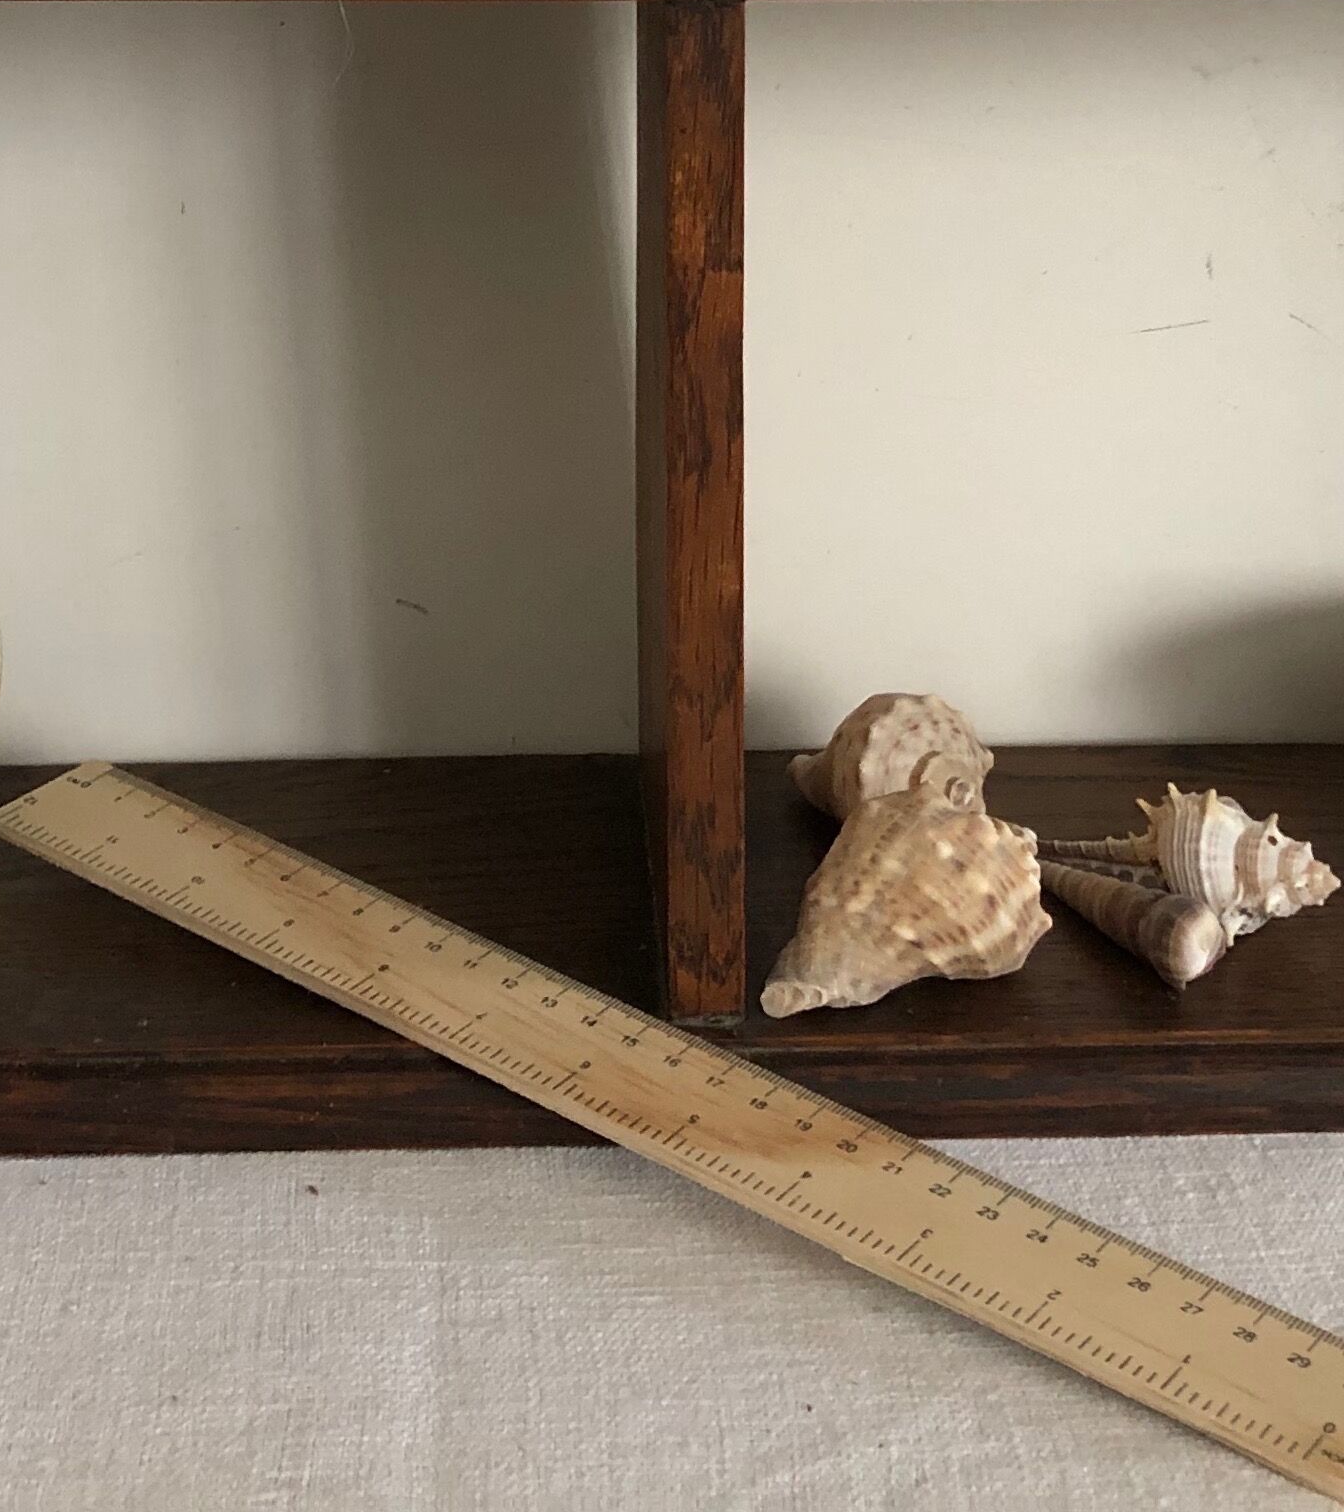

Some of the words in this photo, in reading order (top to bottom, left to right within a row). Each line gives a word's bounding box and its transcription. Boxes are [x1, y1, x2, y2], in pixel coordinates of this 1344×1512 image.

[424, 941, 443, 953] 10
[464, 959, 478, 970] 11
[501, 977, 519, 990] 12
[541, 996, 558, 1008] 13
[580, 1015, 598, 1028] 14
[621, 1035, 640, 1048] 15
[663, 1054, 683, 1068] 16
[705, 1076, 725, 1088] 17
[749, 1098, 768, 1110] 18
[794, 1118, 813, 1132] 19
[836, 1139, 858, 1154] 20
[881, 1161, 903, 1175] 21
[928, 1183, 952, 1199] 22
[976, 1206, 1000, 1221] 23
[1026, 1229, 1048, 1244] 24
[1076, 1253, 1100, 1269] 25
[1127, 1277, 1152, 1293] 26
[1179, 1301, 1205, 1315] 27
[1232, 1326, 1258, 1343] 28
[1286, 1352, 1312, 1369] 29
[688, 1113, 701, 1125] 5
[920, 1228, 934, 1239] 3
[1046, 1289, 1063, 1301] 2
[1182, 1354, 1192, 1365] 1
[1322, 1421, 1337, 1434] 0
